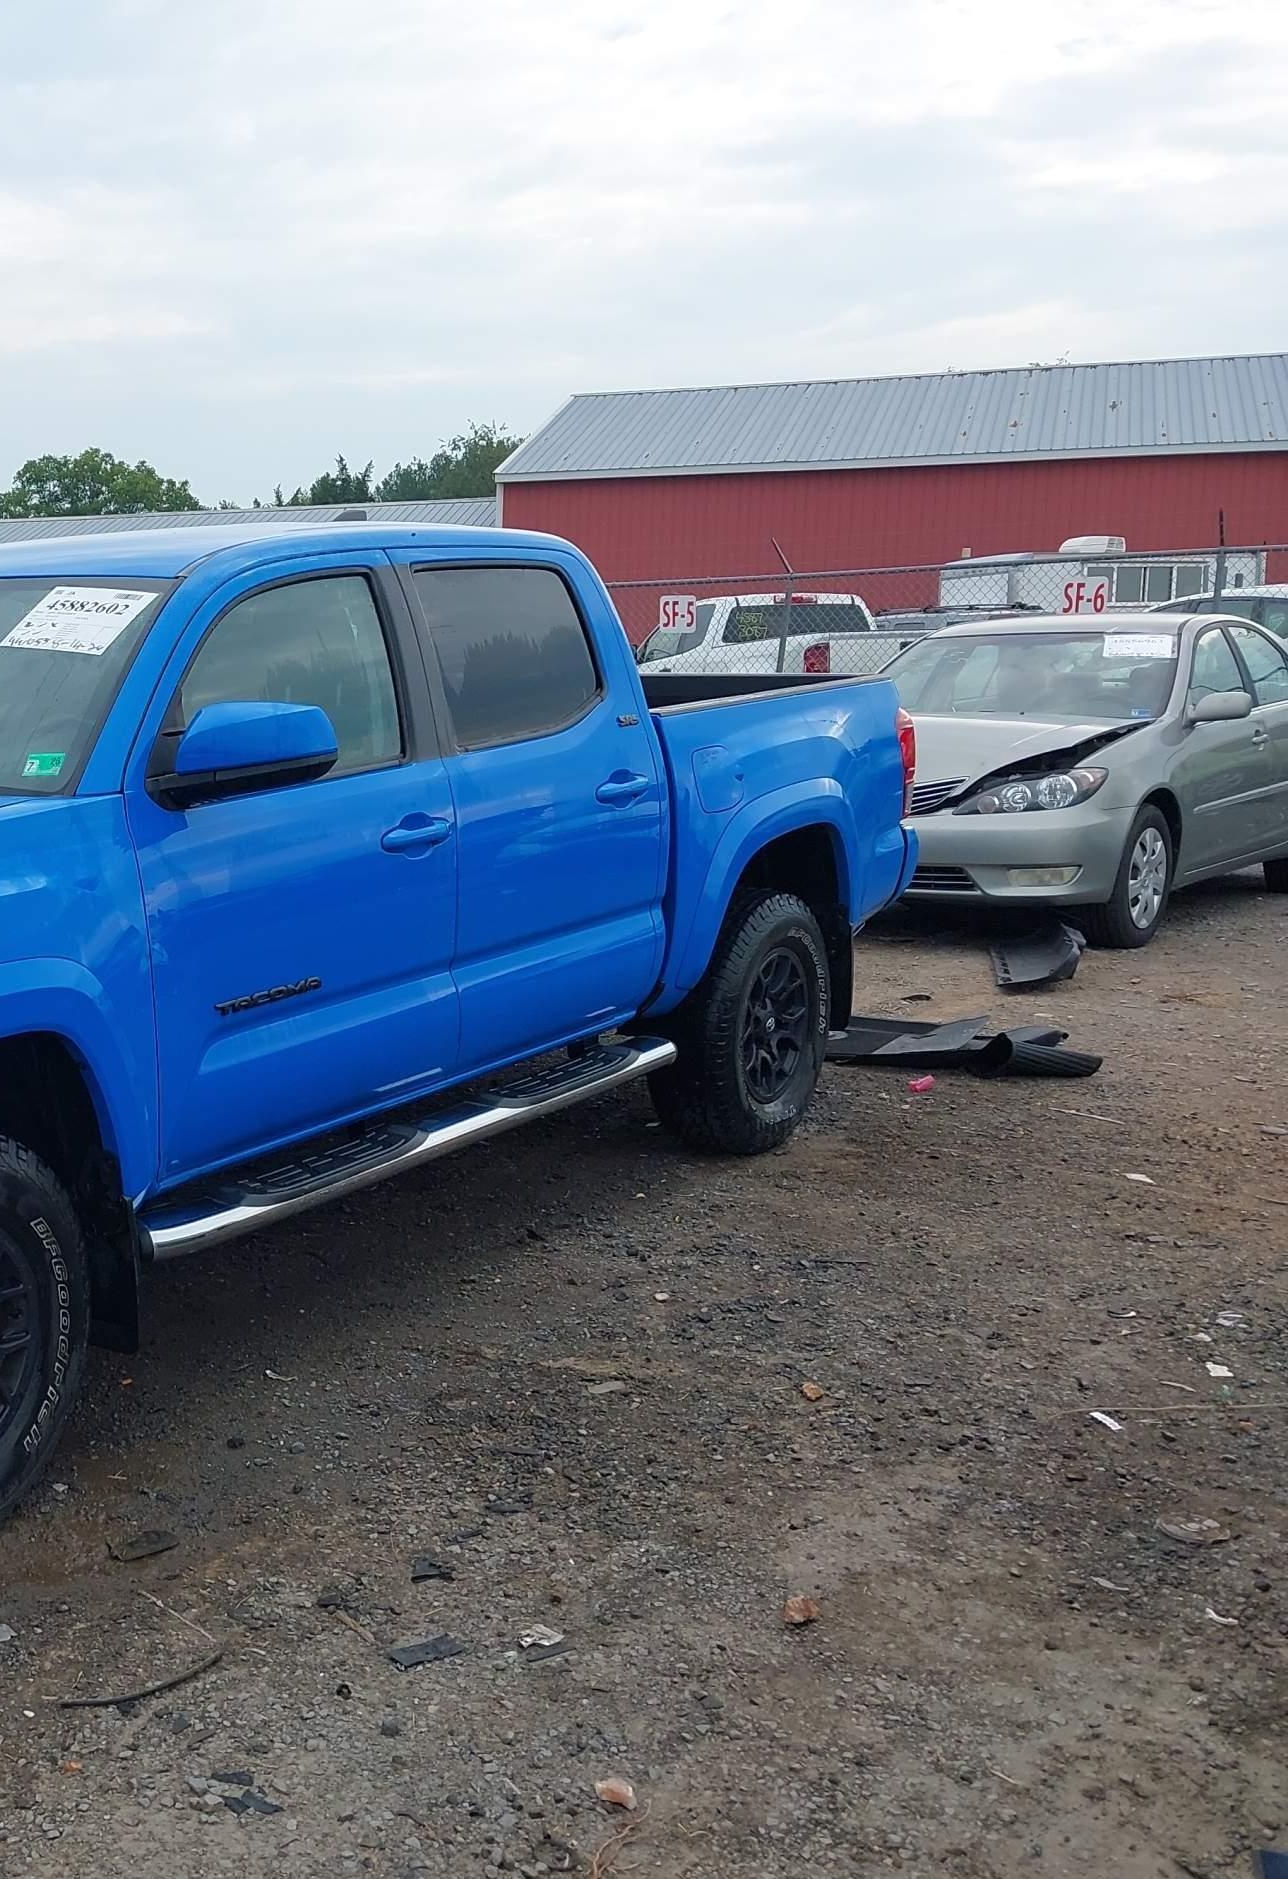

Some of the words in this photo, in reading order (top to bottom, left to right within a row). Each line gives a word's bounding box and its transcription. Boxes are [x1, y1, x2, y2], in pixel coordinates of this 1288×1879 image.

[46, 599, 130, 616] 45882602
[1062, 582, 1105, 613] SF-6
[662, 600, 695, 628] SF-5
[214, 976, 322, 1016] TACOMA
[23, 1216, 71, 1452] BFGoodrich
